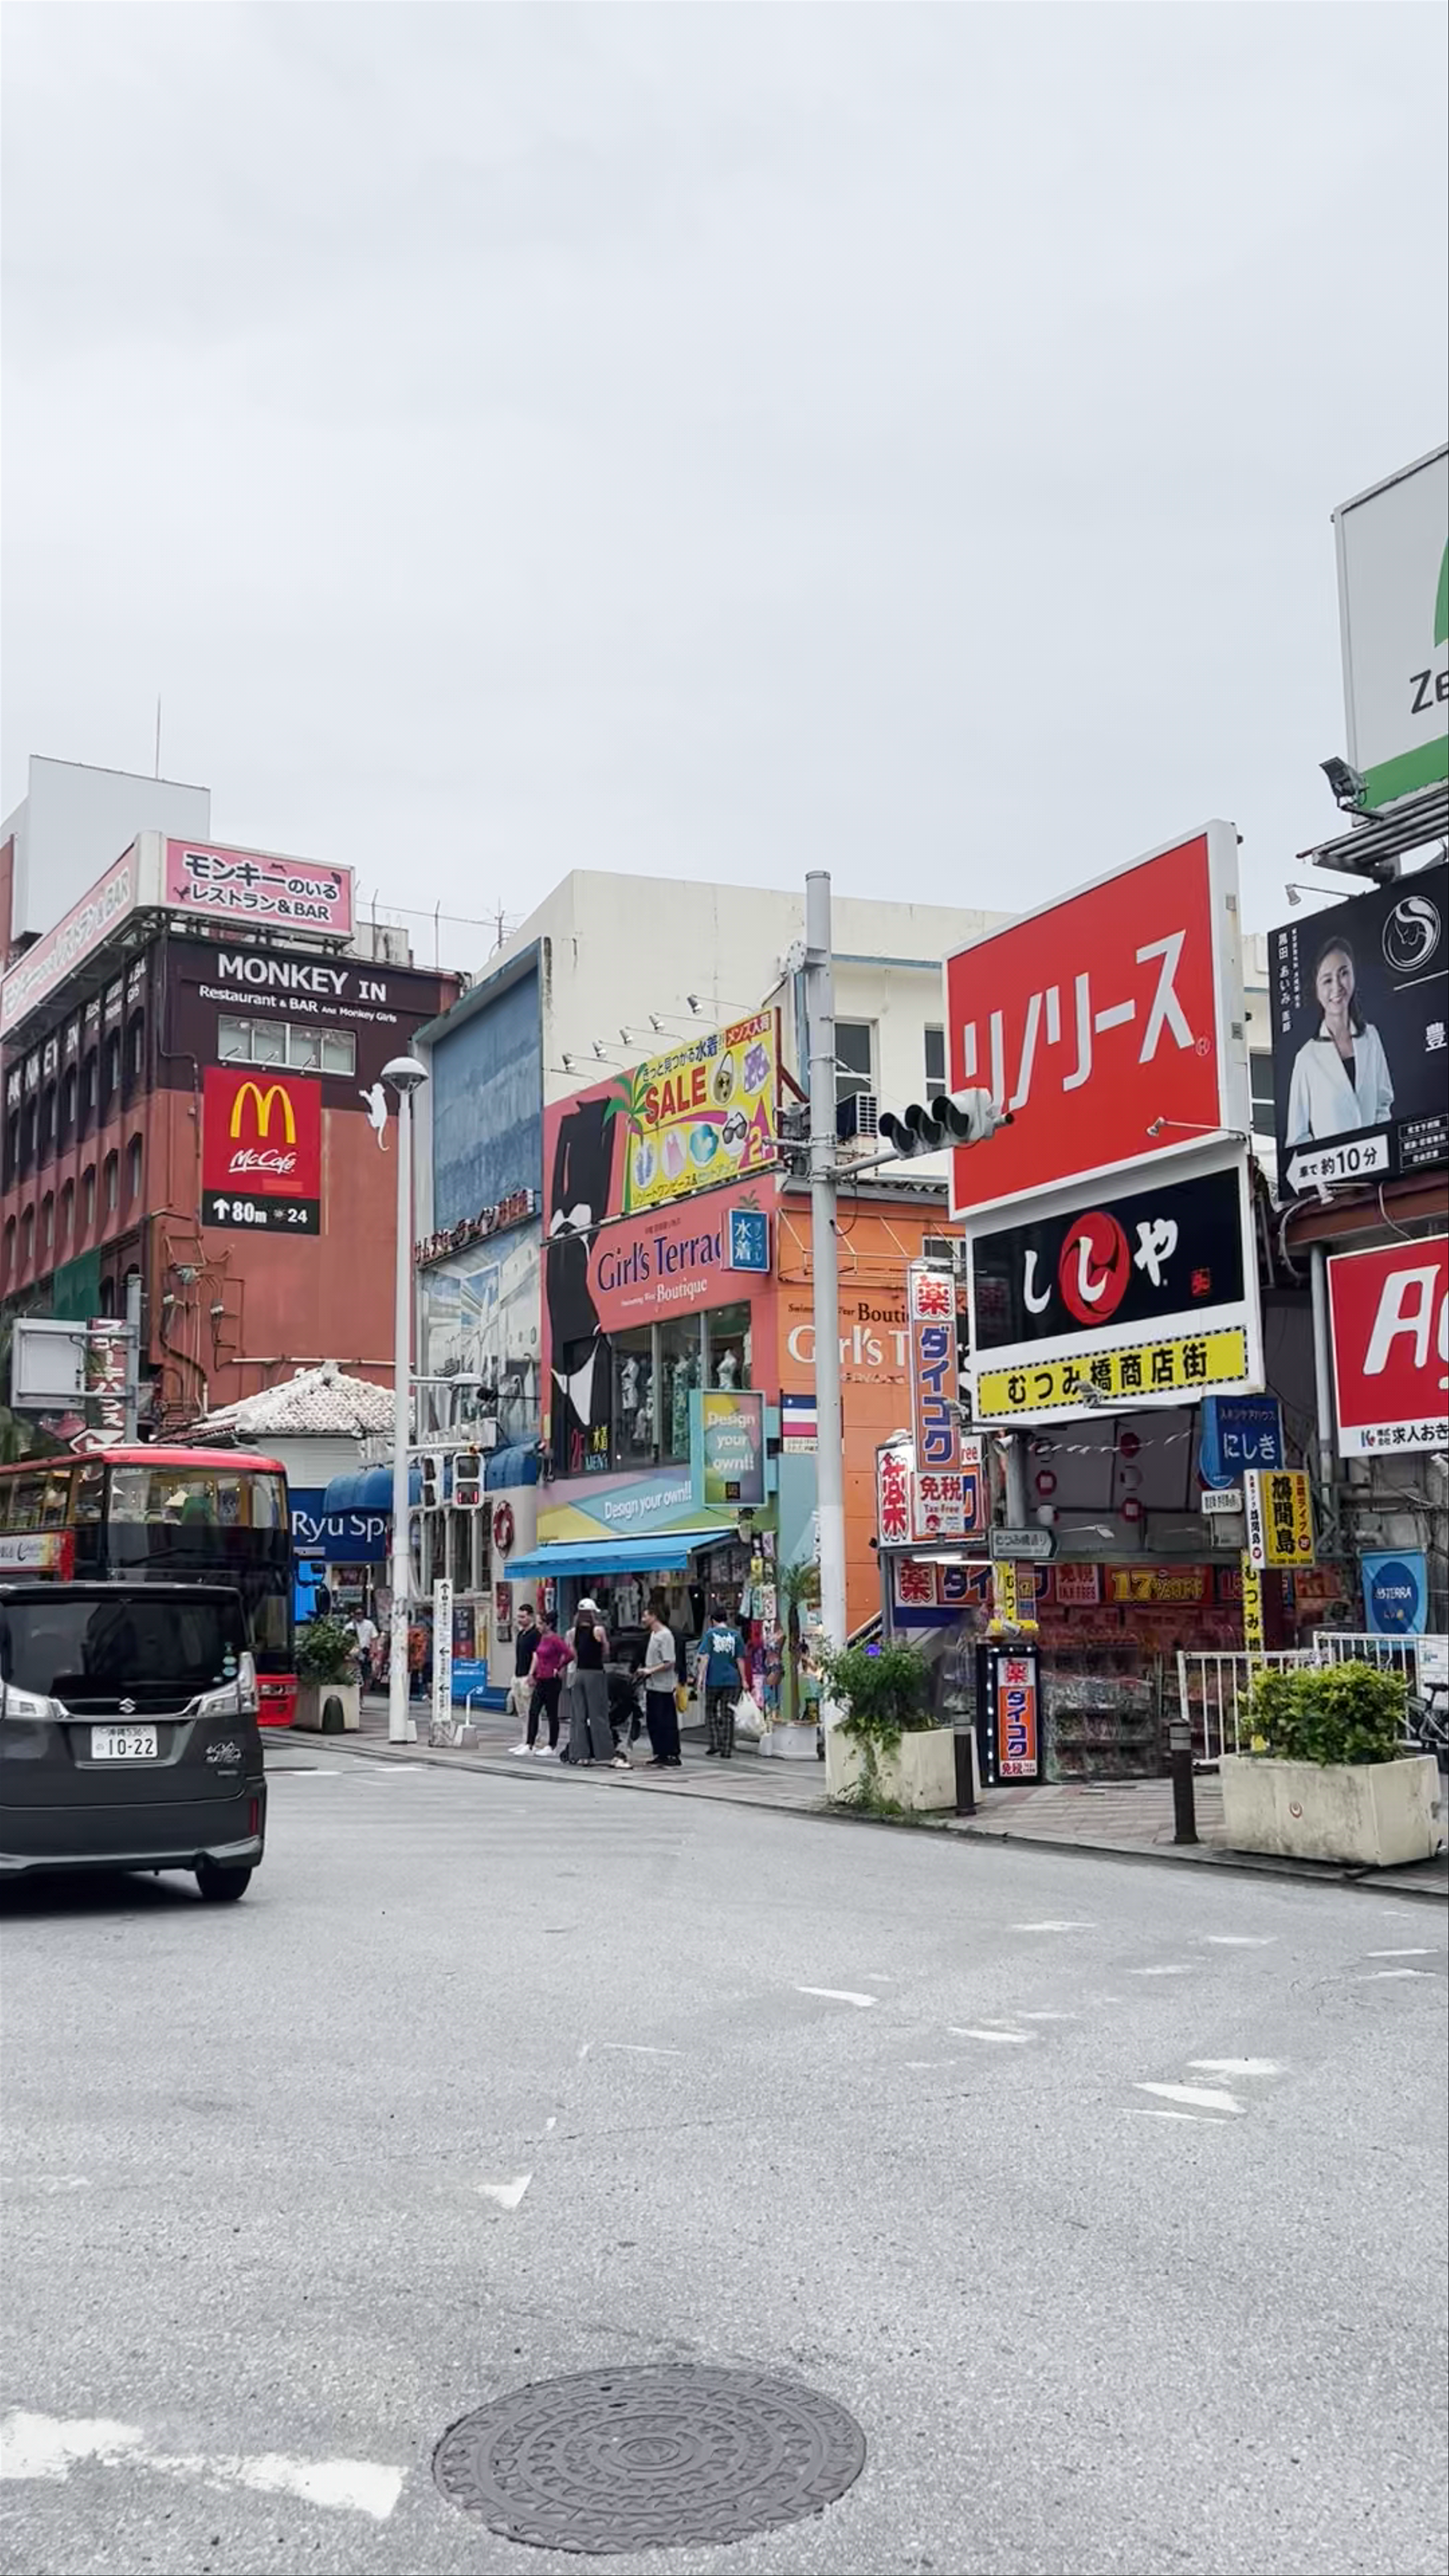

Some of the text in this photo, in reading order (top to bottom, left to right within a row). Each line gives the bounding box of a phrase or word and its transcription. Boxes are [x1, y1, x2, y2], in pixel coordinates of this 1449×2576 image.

[185, 853, 338, 900] モンキーのいる
[192, 884, 329, 921] レストラン&BAR
[218, 953, 387, 1002] MONKEY IN
[199, 985, 276, 1007] Restaurant
[289, 997, 318, 1013] BAR
[340, 1007, 374, 1021] Monkey
[376, 1011, 397, 1023] Girls
[1426, 1021, 1447, 1052] 豊
[644, 1065, 706, 1125] SALE
[232, 1201, 308, 1223] 80m 24
[598, 1241, 650, 1291] Girl's
[1023, 1218, 1179, 1314] ししや
[1363, 1264, 1448, 1375] A
[787, 1324, 883, 1367] Grl's
[1008, 1343, 1207, 1404] むつみ橋商店街
[921, 1325, 953, 1463] ダイコク
[708, 1412, 755, 1428] Design
[717, 1435, 748, 1449] your
[1223, 1432, 1275, 1459] にしき
[605, 1498, 638, 1519] Design
[639, 1492, 663, 1518] your
[920, 1475, 962, 1501] 免税
[291, 1510, 388, 1543] Ryu Sp
[1007, 1691, 1028, 1757] ダイコク
[109, 1738, 153, 1756] 10-22
[1002, 1762, 1023, 1775] 免税
